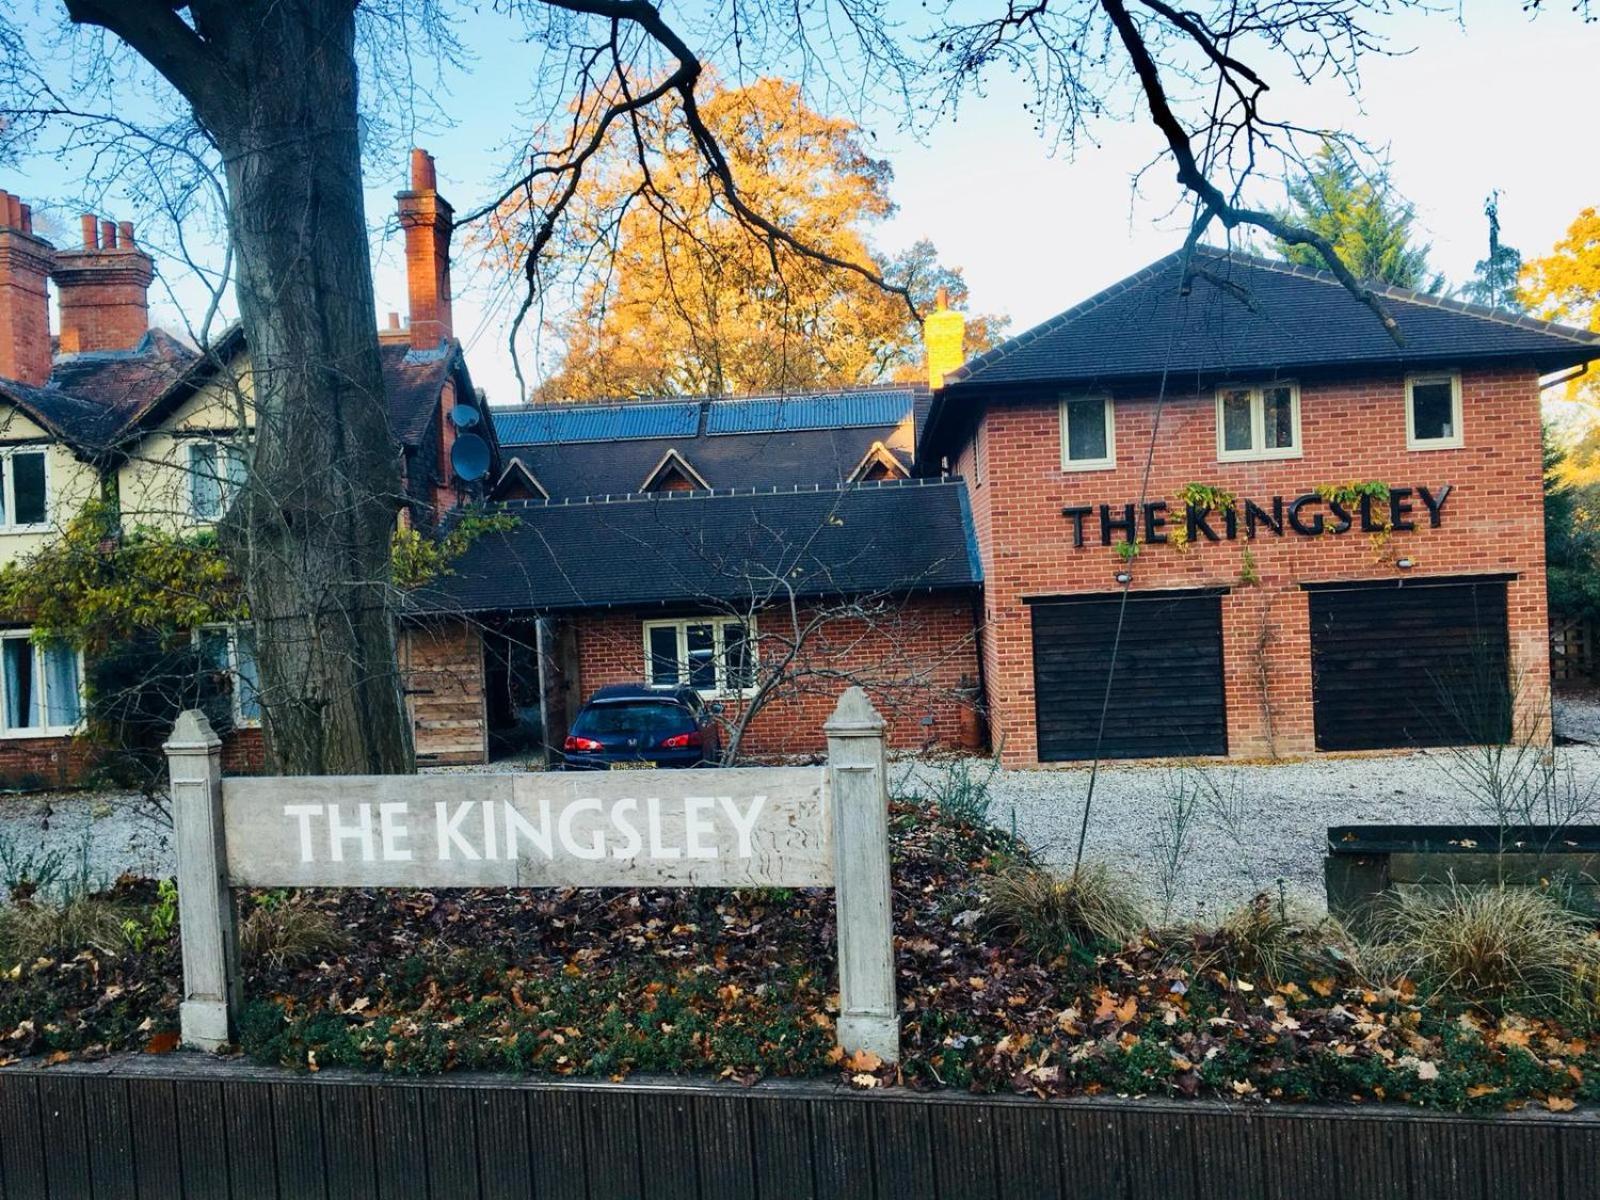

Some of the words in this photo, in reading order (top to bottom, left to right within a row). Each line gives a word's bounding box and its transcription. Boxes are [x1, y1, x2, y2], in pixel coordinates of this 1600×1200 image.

[1061, 502, 1168, 547] THE
[1183, 485, 1453, 543] KINGSLEY
[284, 801, 413, 862] THE
[436, 796, 768, 861] KINGSLEY
